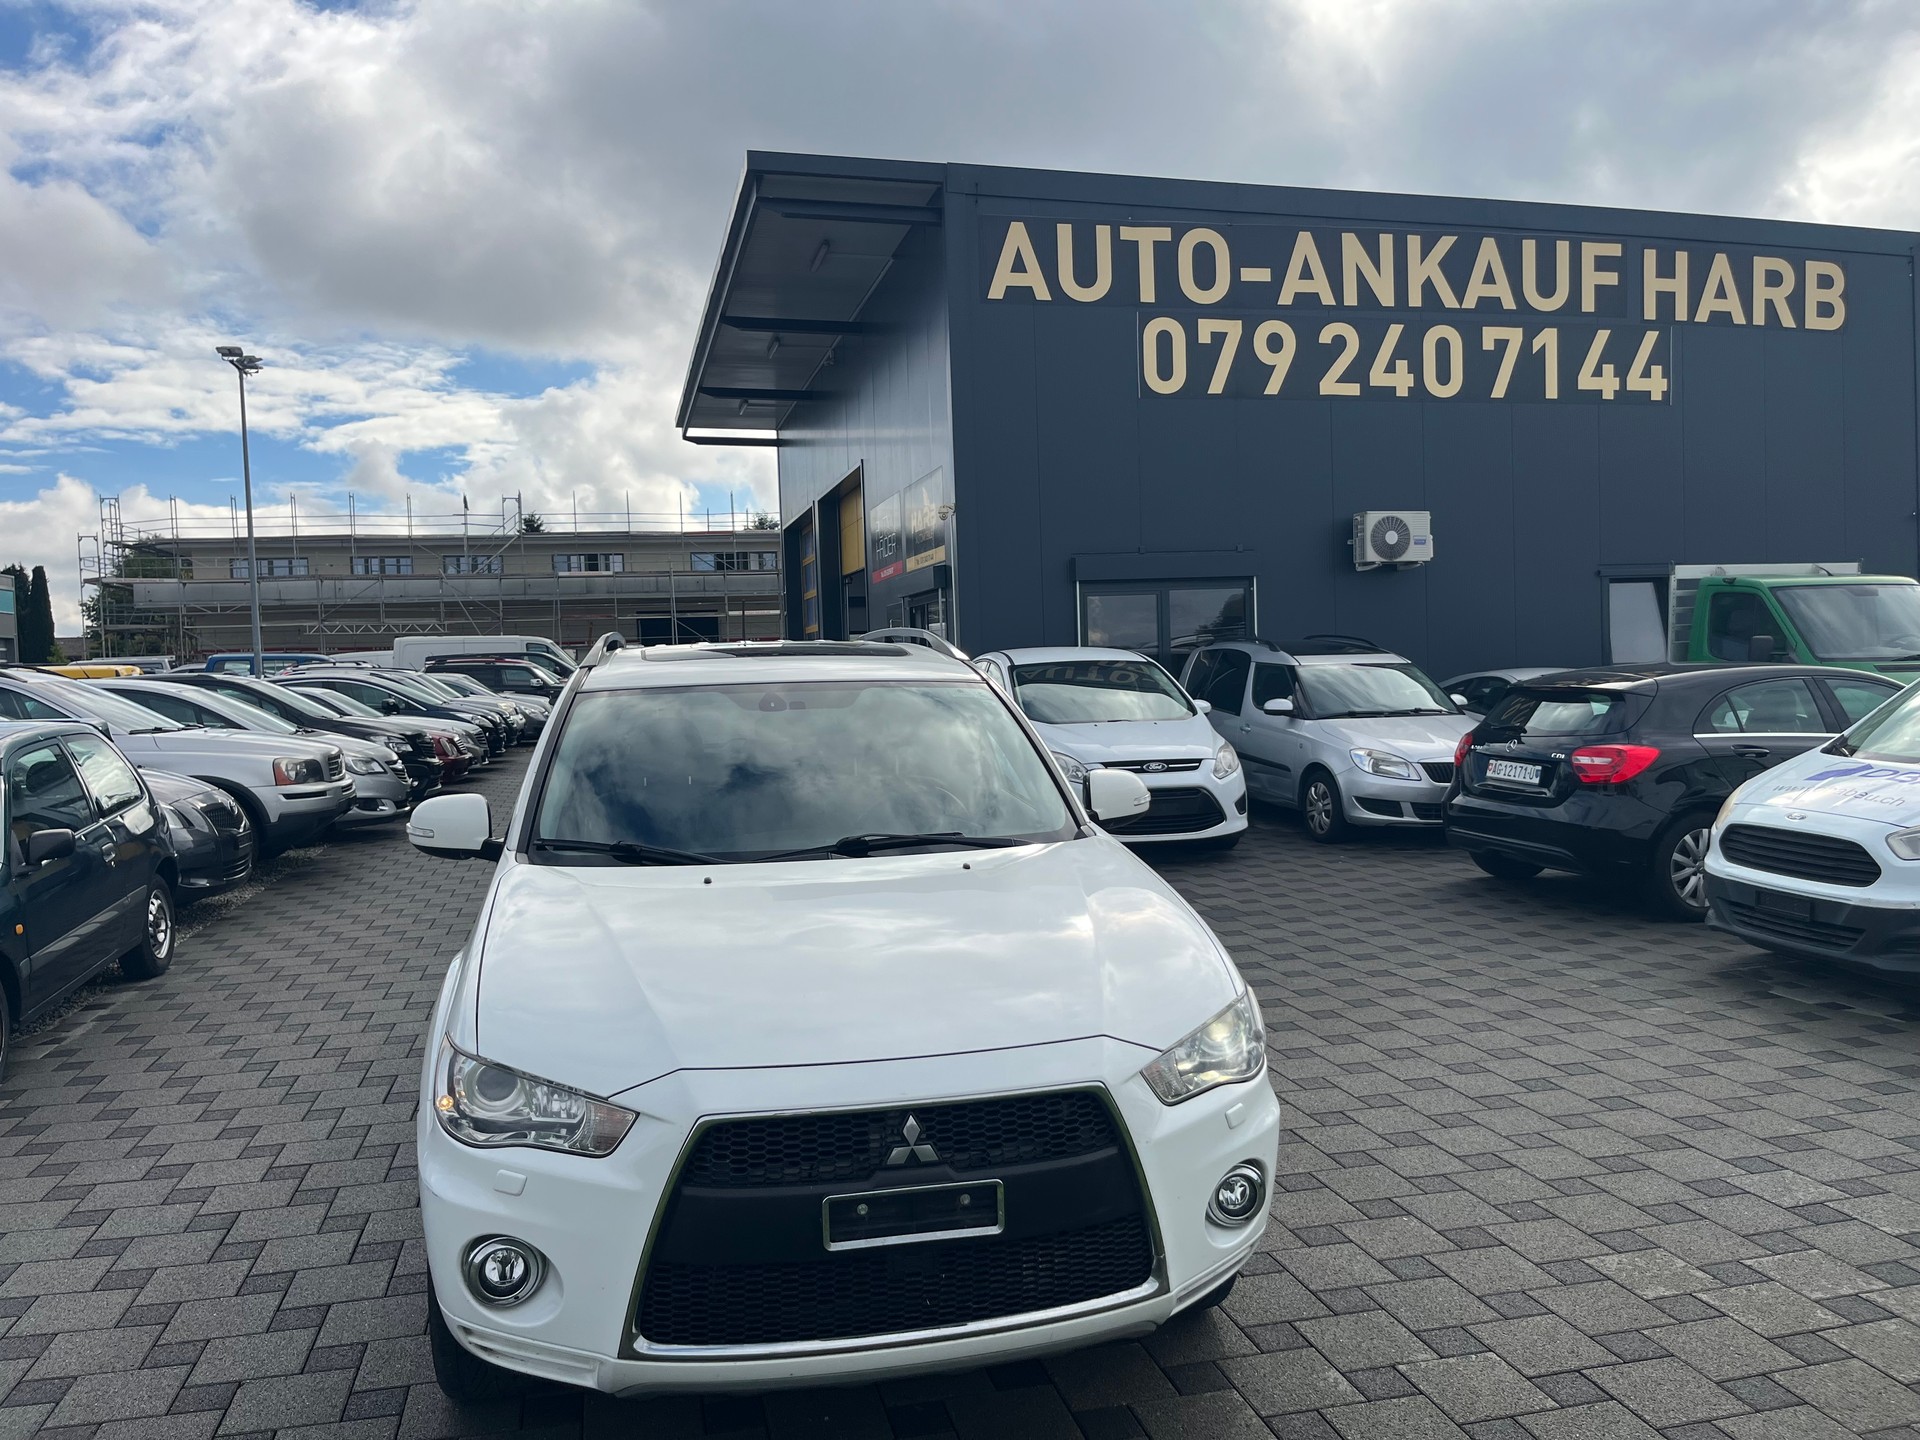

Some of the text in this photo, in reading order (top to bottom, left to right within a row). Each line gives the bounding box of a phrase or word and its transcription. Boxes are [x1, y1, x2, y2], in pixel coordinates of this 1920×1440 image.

[987, 221, 1846, 331] AUTO-ANKAUF HARB
[1142, 316, 1668, 401] 079 240 71 44
